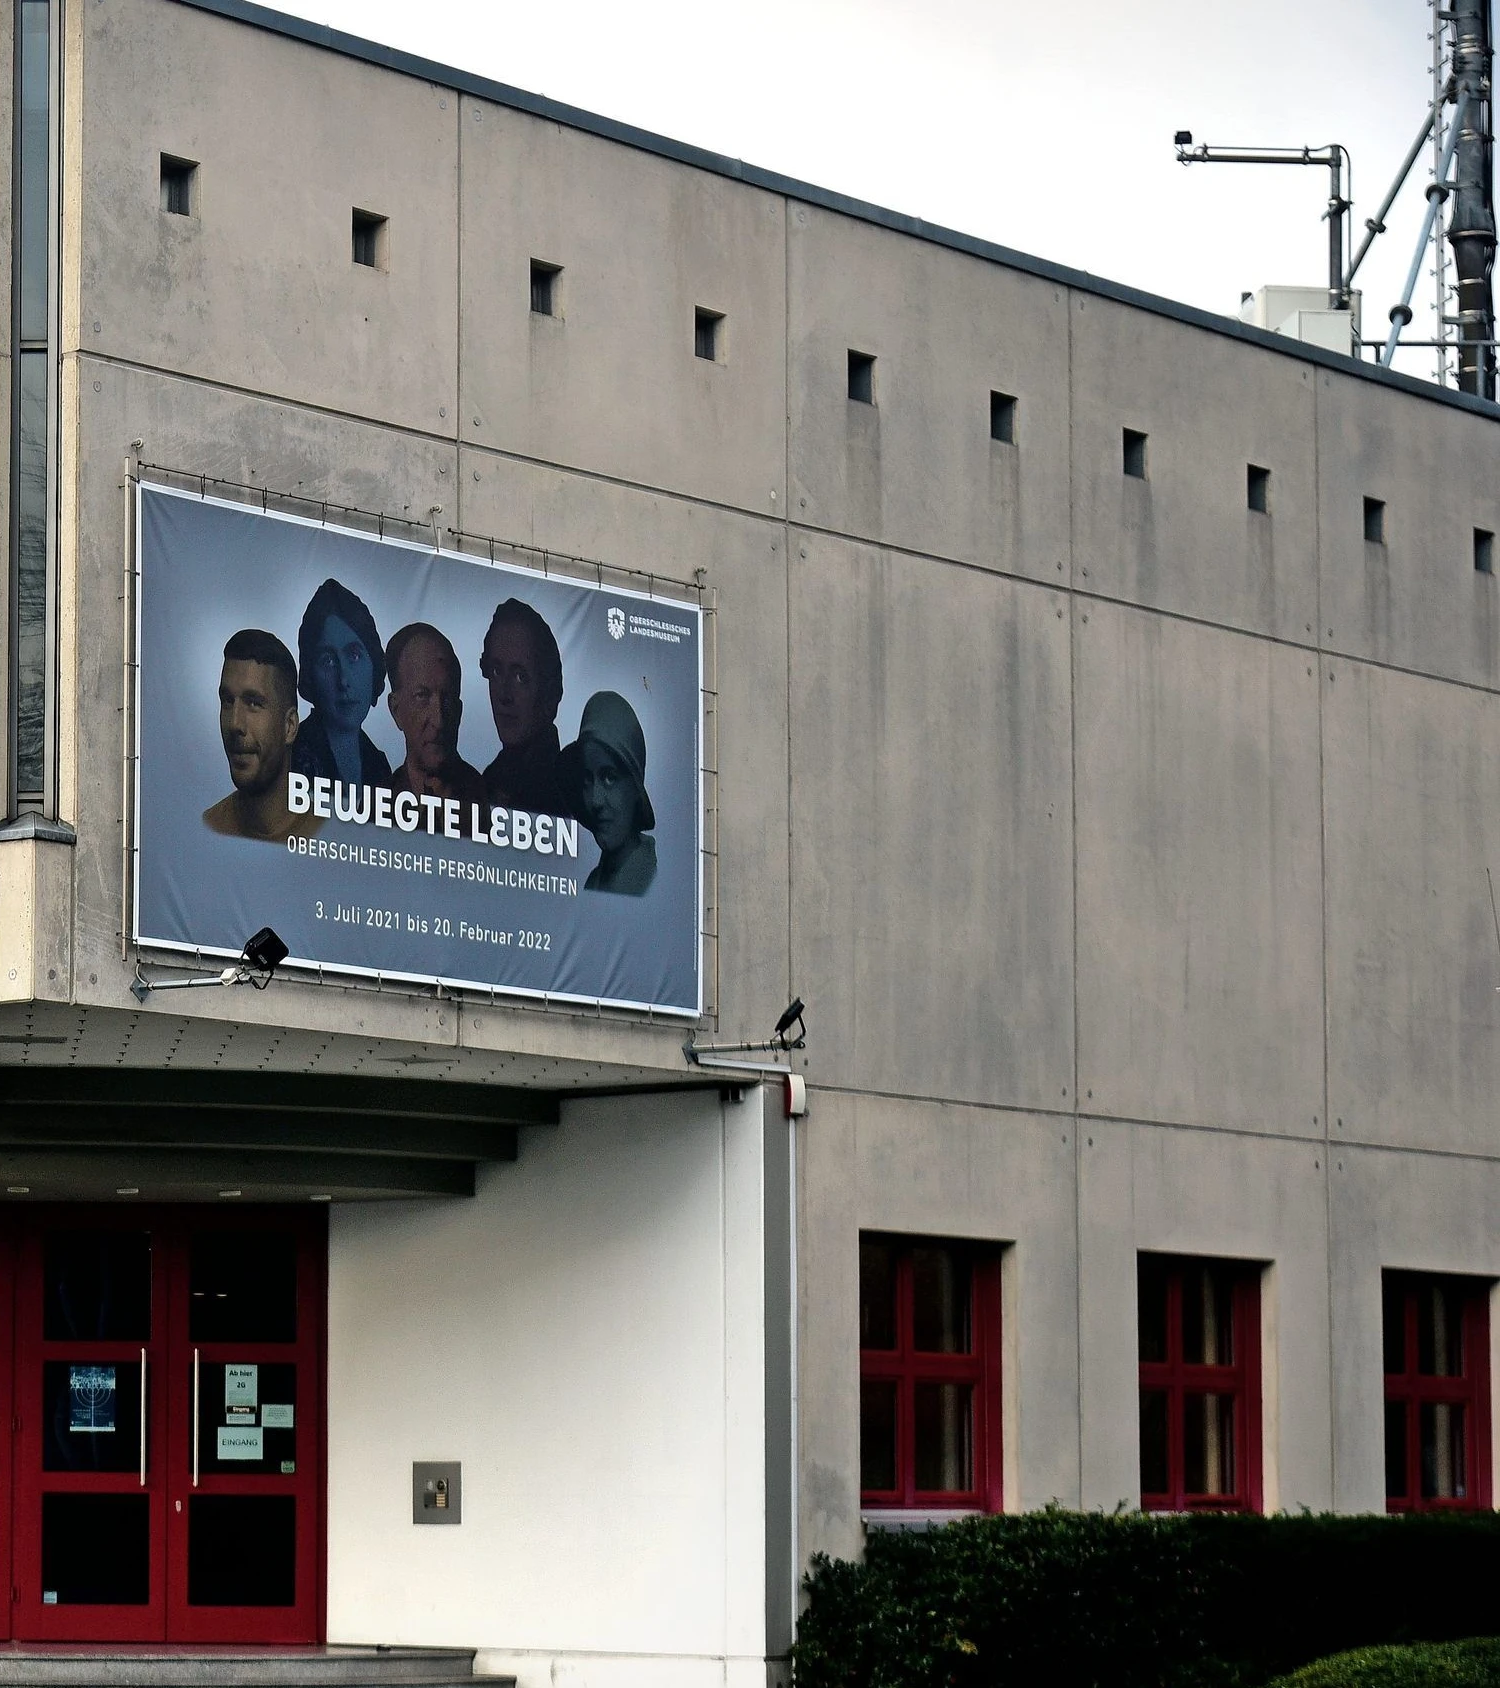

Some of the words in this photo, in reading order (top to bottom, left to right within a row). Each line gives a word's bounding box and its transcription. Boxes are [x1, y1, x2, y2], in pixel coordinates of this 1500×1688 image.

[629, 615, 691, 635] OBERSCHLESISCHES
[629, 625, 681, 643] LANDESMUSEUM
[288, 771, 461, 839] BEWEGTE
[471, 802, 578, 858] LEBEN
[287, 835, 433, 875] OBERSCHLESISCHE
[438, 858, 577, 897] PERSÖNLICHKEITEN
[315, 900, 328, 920] 3.
[333, 903, 361, 924] Juli
[366, 908, 400, 930] 2021
[407, 914, 429, 934] bis
[434, 917, 455, 938] 20.
[460, 921, 514, 946] Februar
[518, 929, 551, 952] 2022
[222, 1438, 258, 1447] EINGANG
